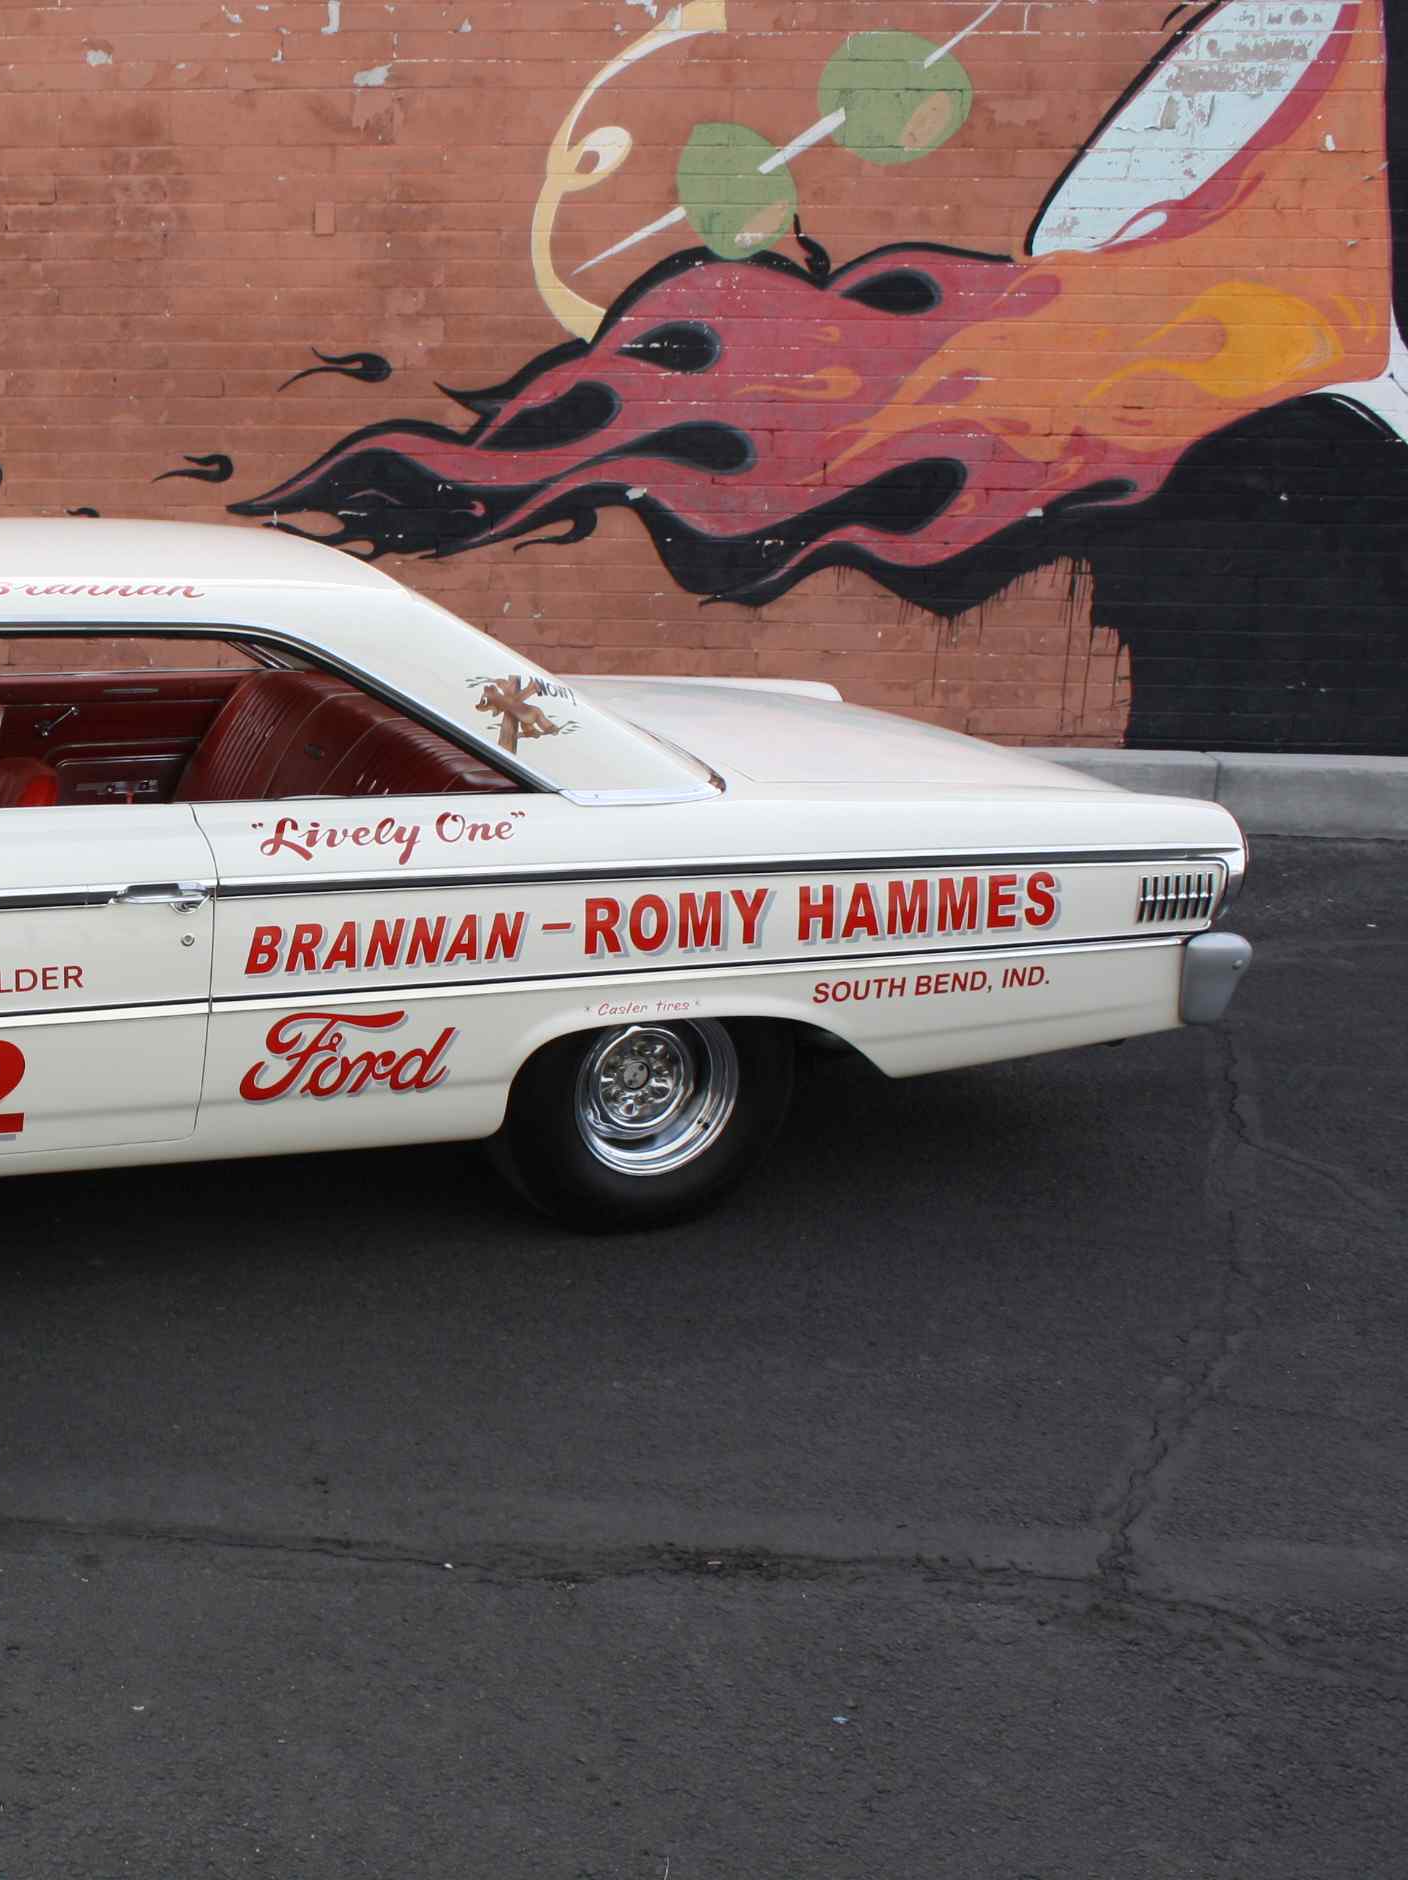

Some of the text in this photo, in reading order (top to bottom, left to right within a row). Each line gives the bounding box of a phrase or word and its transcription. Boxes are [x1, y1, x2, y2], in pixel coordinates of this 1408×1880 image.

[244, 911, 529, 978] BRANNAN
[583, 887, 772, 960] ROMY
[797, 871, 1064, 945] HAMMES
[811, 964, 1052, 1004] SOUTH BEND, IND.
[239, 1008, 460, 1104] Ford
